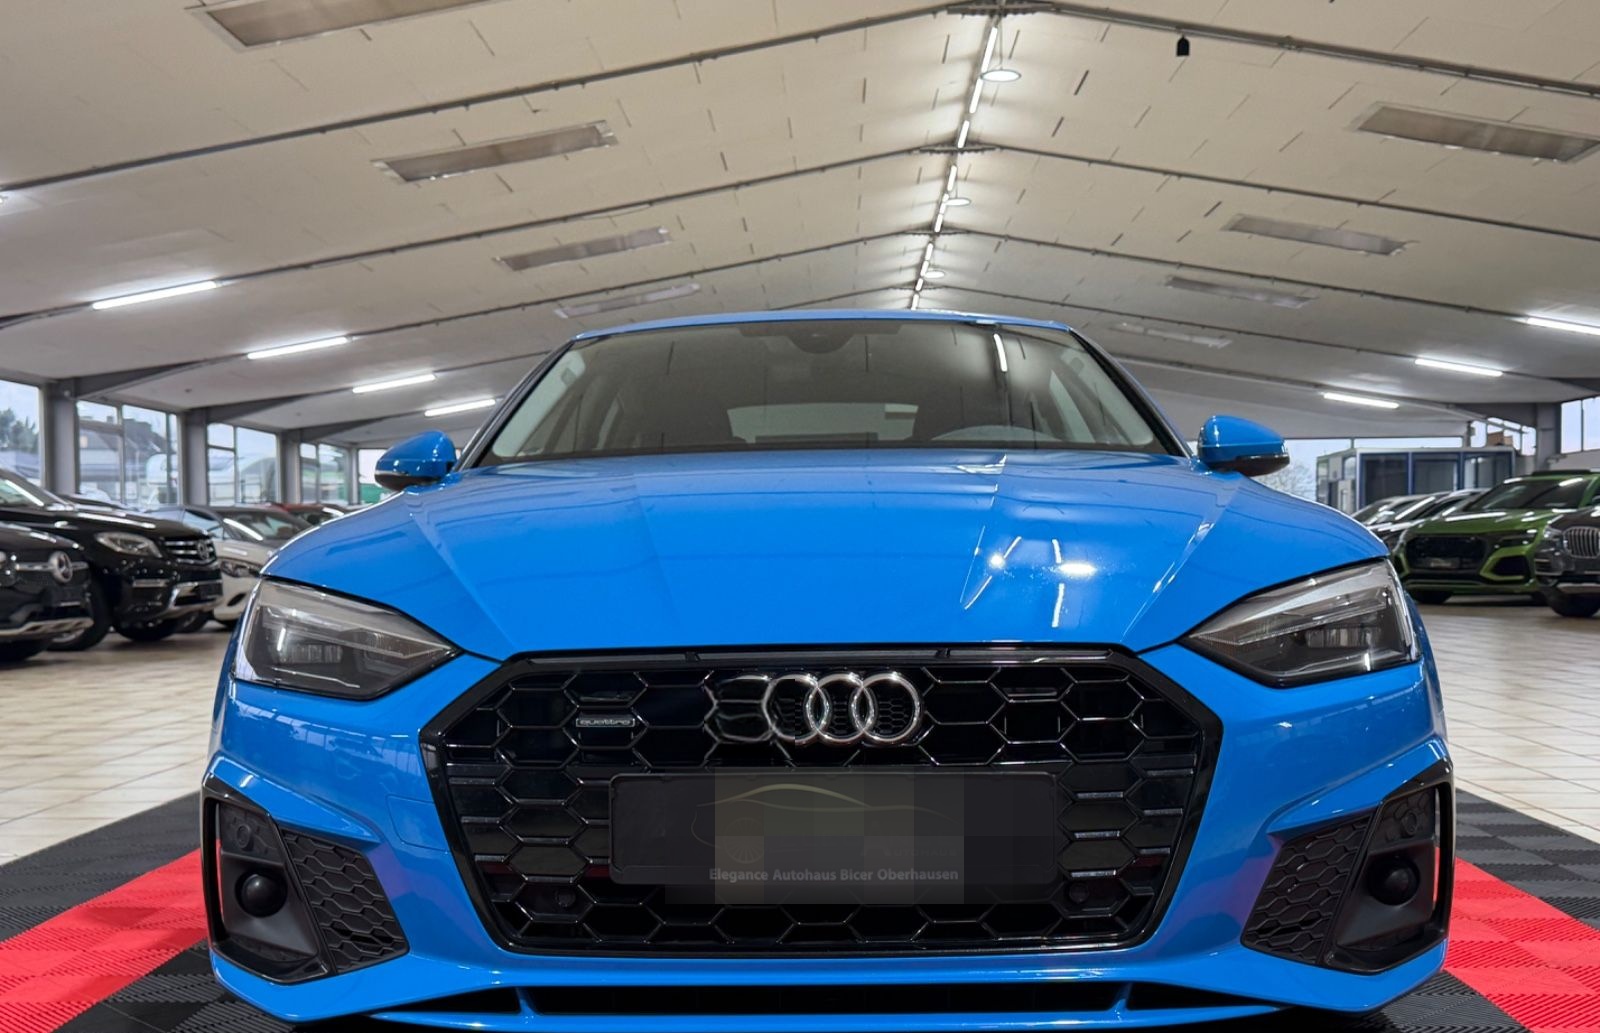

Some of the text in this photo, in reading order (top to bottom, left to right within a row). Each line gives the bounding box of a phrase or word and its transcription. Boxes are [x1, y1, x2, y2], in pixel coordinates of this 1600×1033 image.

[708, 868, 959, 883] Elegance Autohaus Bicer Oberhausen
